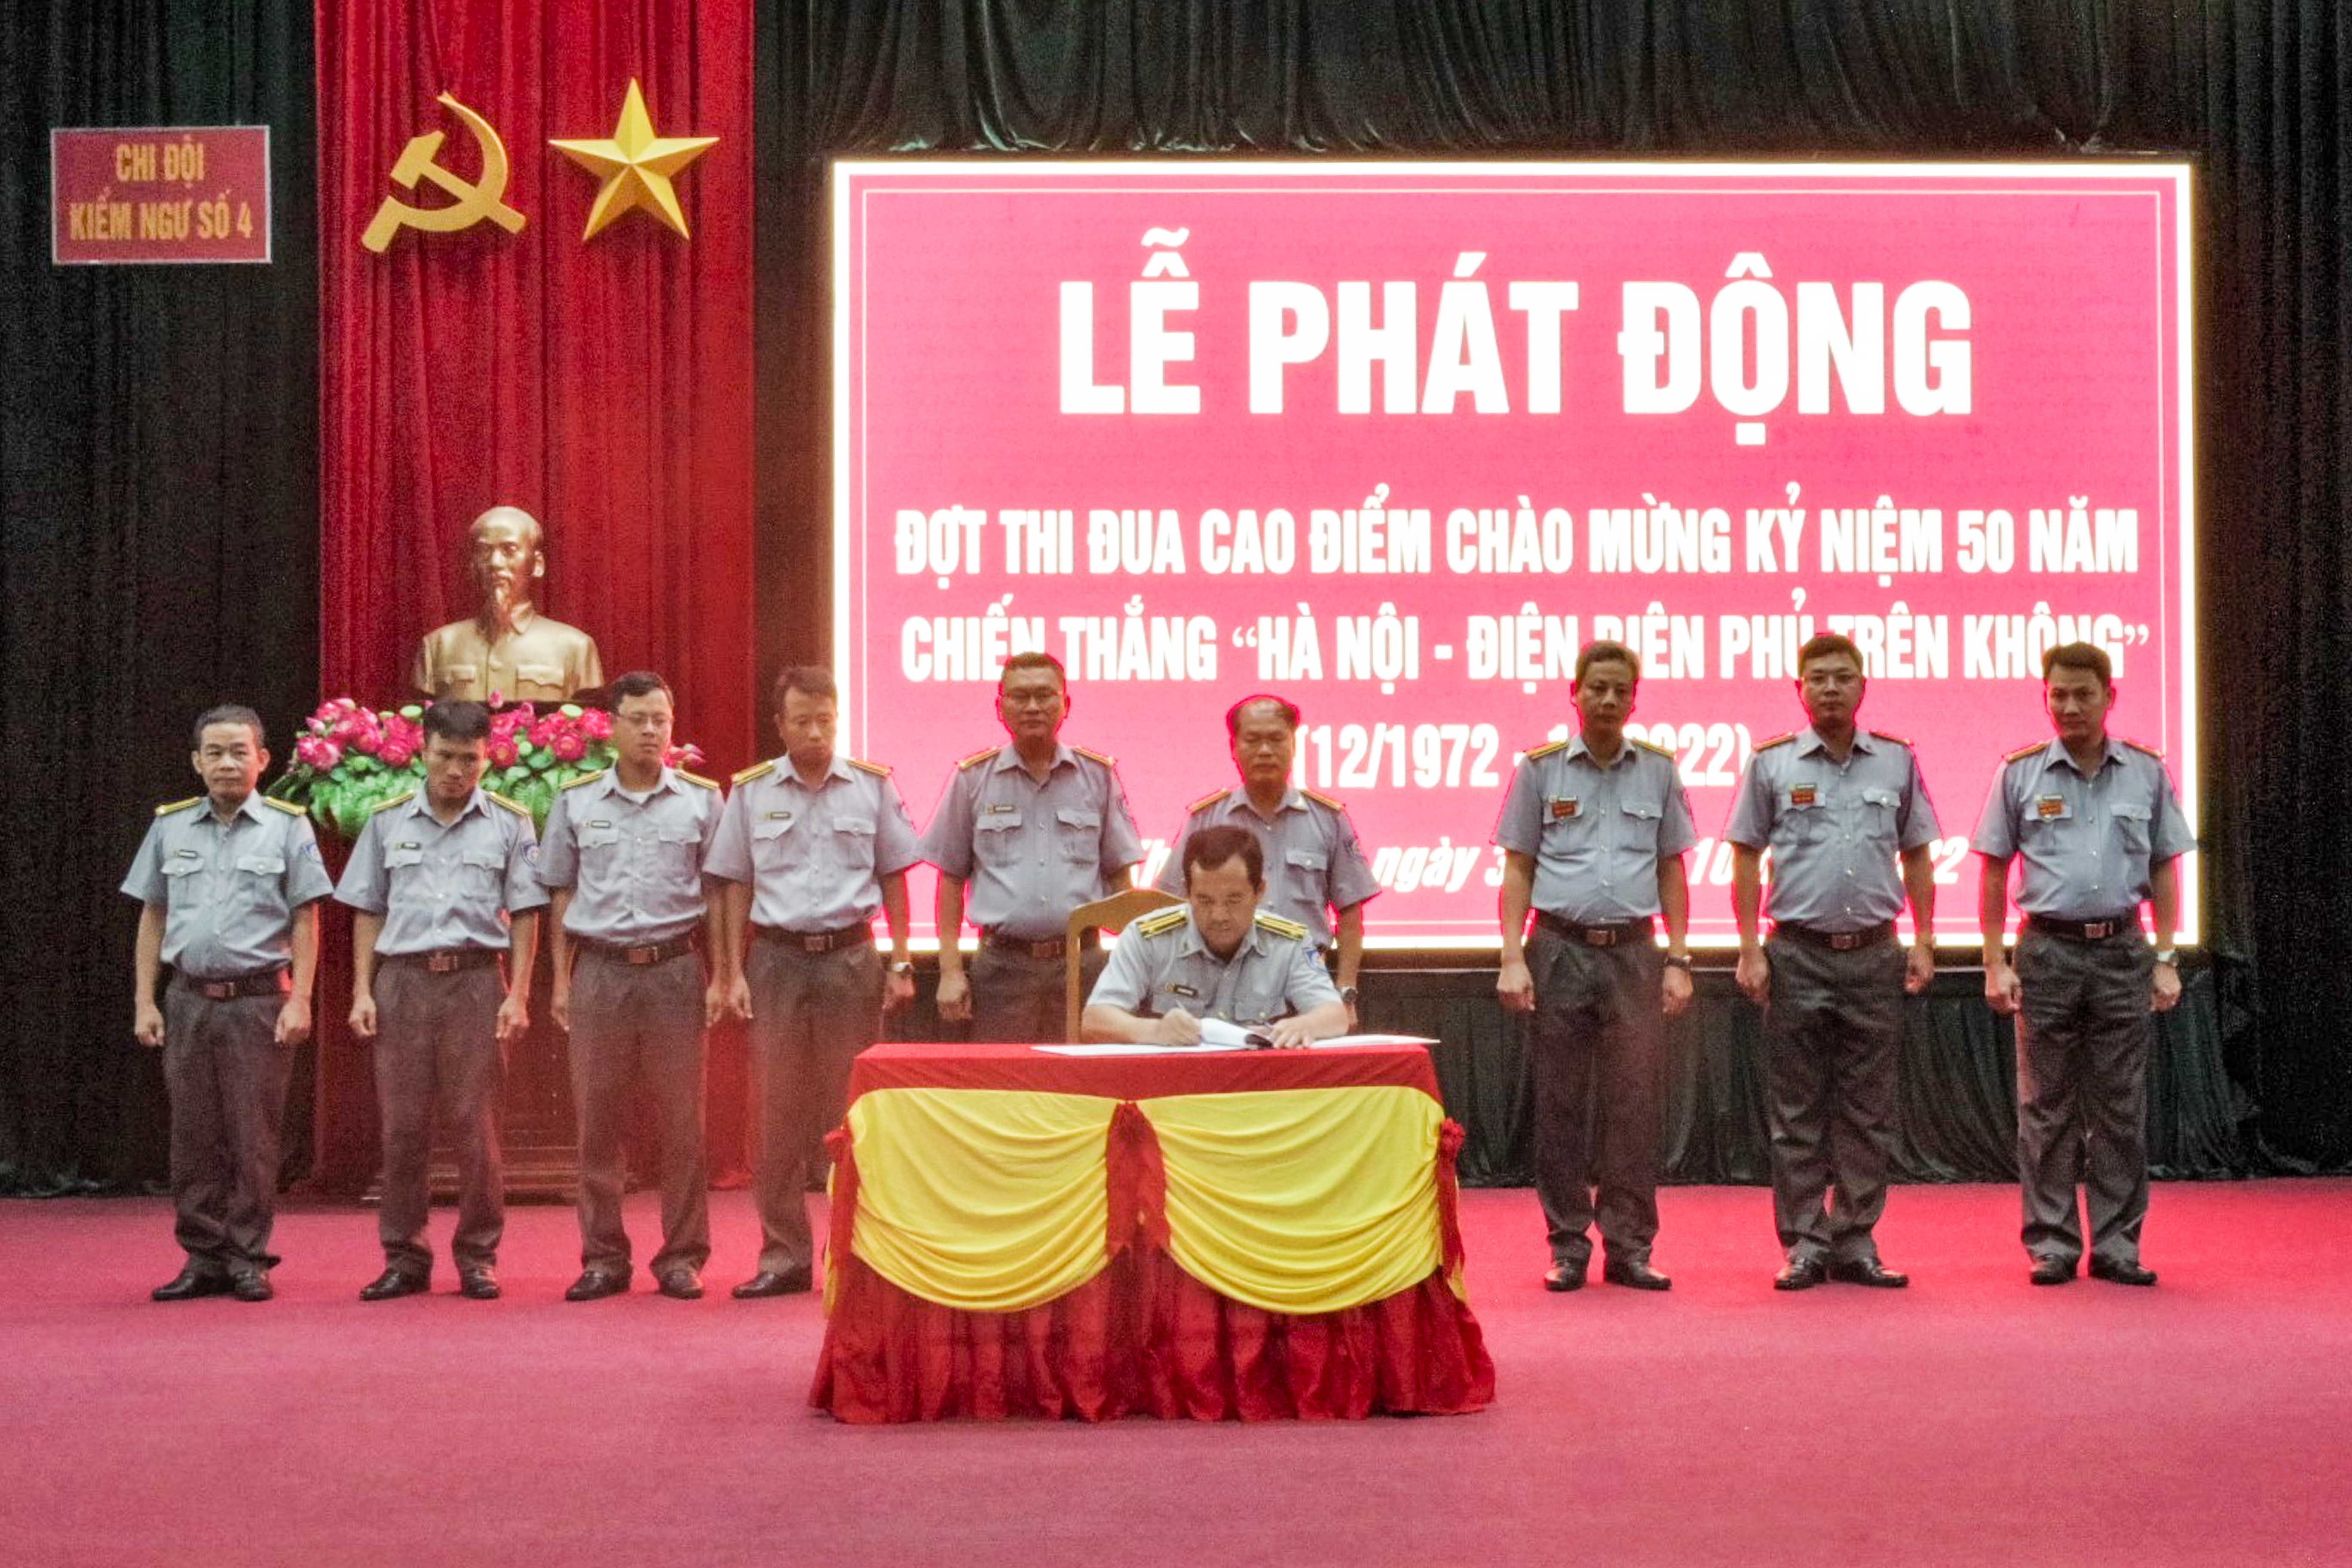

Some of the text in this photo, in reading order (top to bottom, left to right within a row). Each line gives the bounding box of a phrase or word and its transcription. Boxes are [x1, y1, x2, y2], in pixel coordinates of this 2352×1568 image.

[116, 134, 205, 189] CHI ĐỘI
[139, 199, 193, 240] NGƯ
[198, 189, 231, 239] SỐ
[237, 200, 253, 239] 4
[1060, 227, 1972, 445] LỄ PHÁT ĐỘNG
[894, 482, 2138, 590] ĐỢT THI ĐUA CAO ĐIỂM CHÀO MỪNG KỶ NIỆM 50 NĂM
[901, 593, 1046, 682] CHIẾN
[1059, 594, 1218, 681] THẮNG
[1232, 602, 1323, 681] “HÀ
[1336, 602, 1419, 695] NỘI
[1434, 645, 1453, 660] -
[1466, 602, 1579, 694] ĐIỆN
